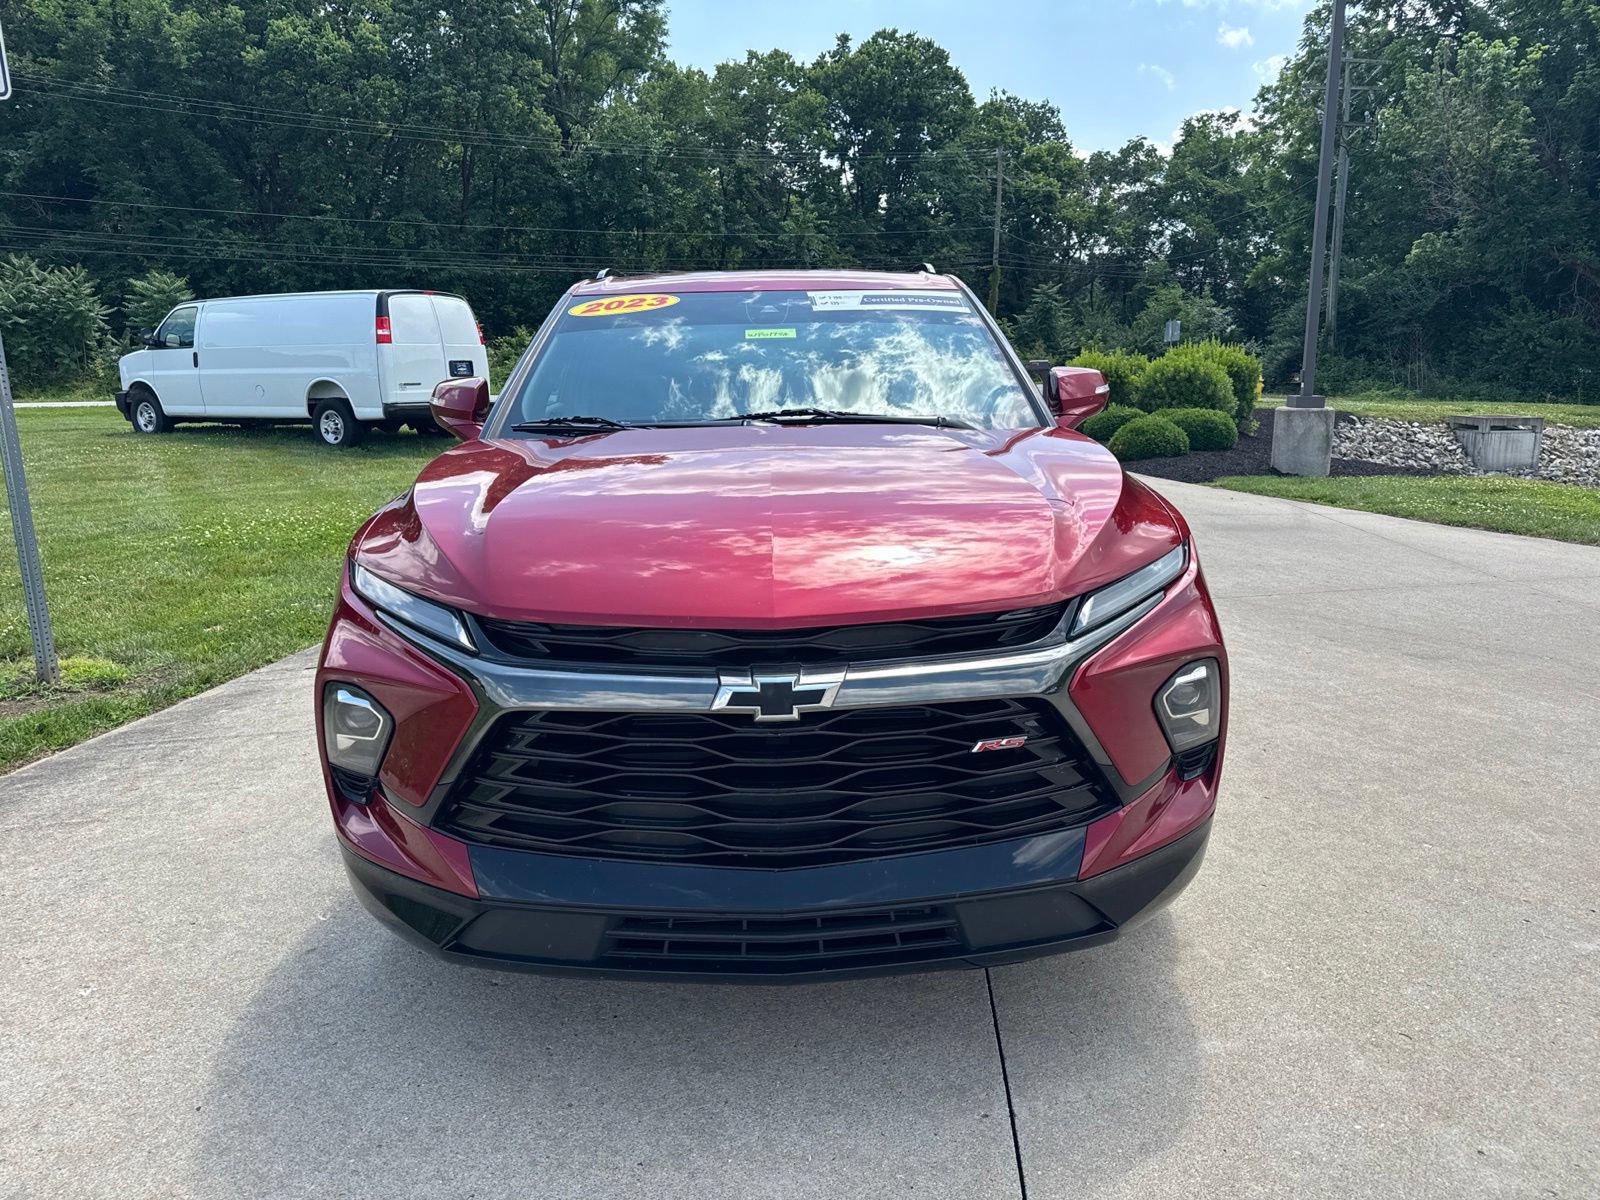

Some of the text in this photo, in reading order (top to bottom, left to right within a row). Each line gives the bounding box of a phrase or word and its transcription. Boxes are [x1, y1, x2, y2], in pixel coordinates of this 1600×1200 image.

[580, 296, 669, 314] 2023
[863, 296, 906, 304] Certified
[908, 296, 961, 306] Pre-Owned
[971, 736, 1028, 752] RS
